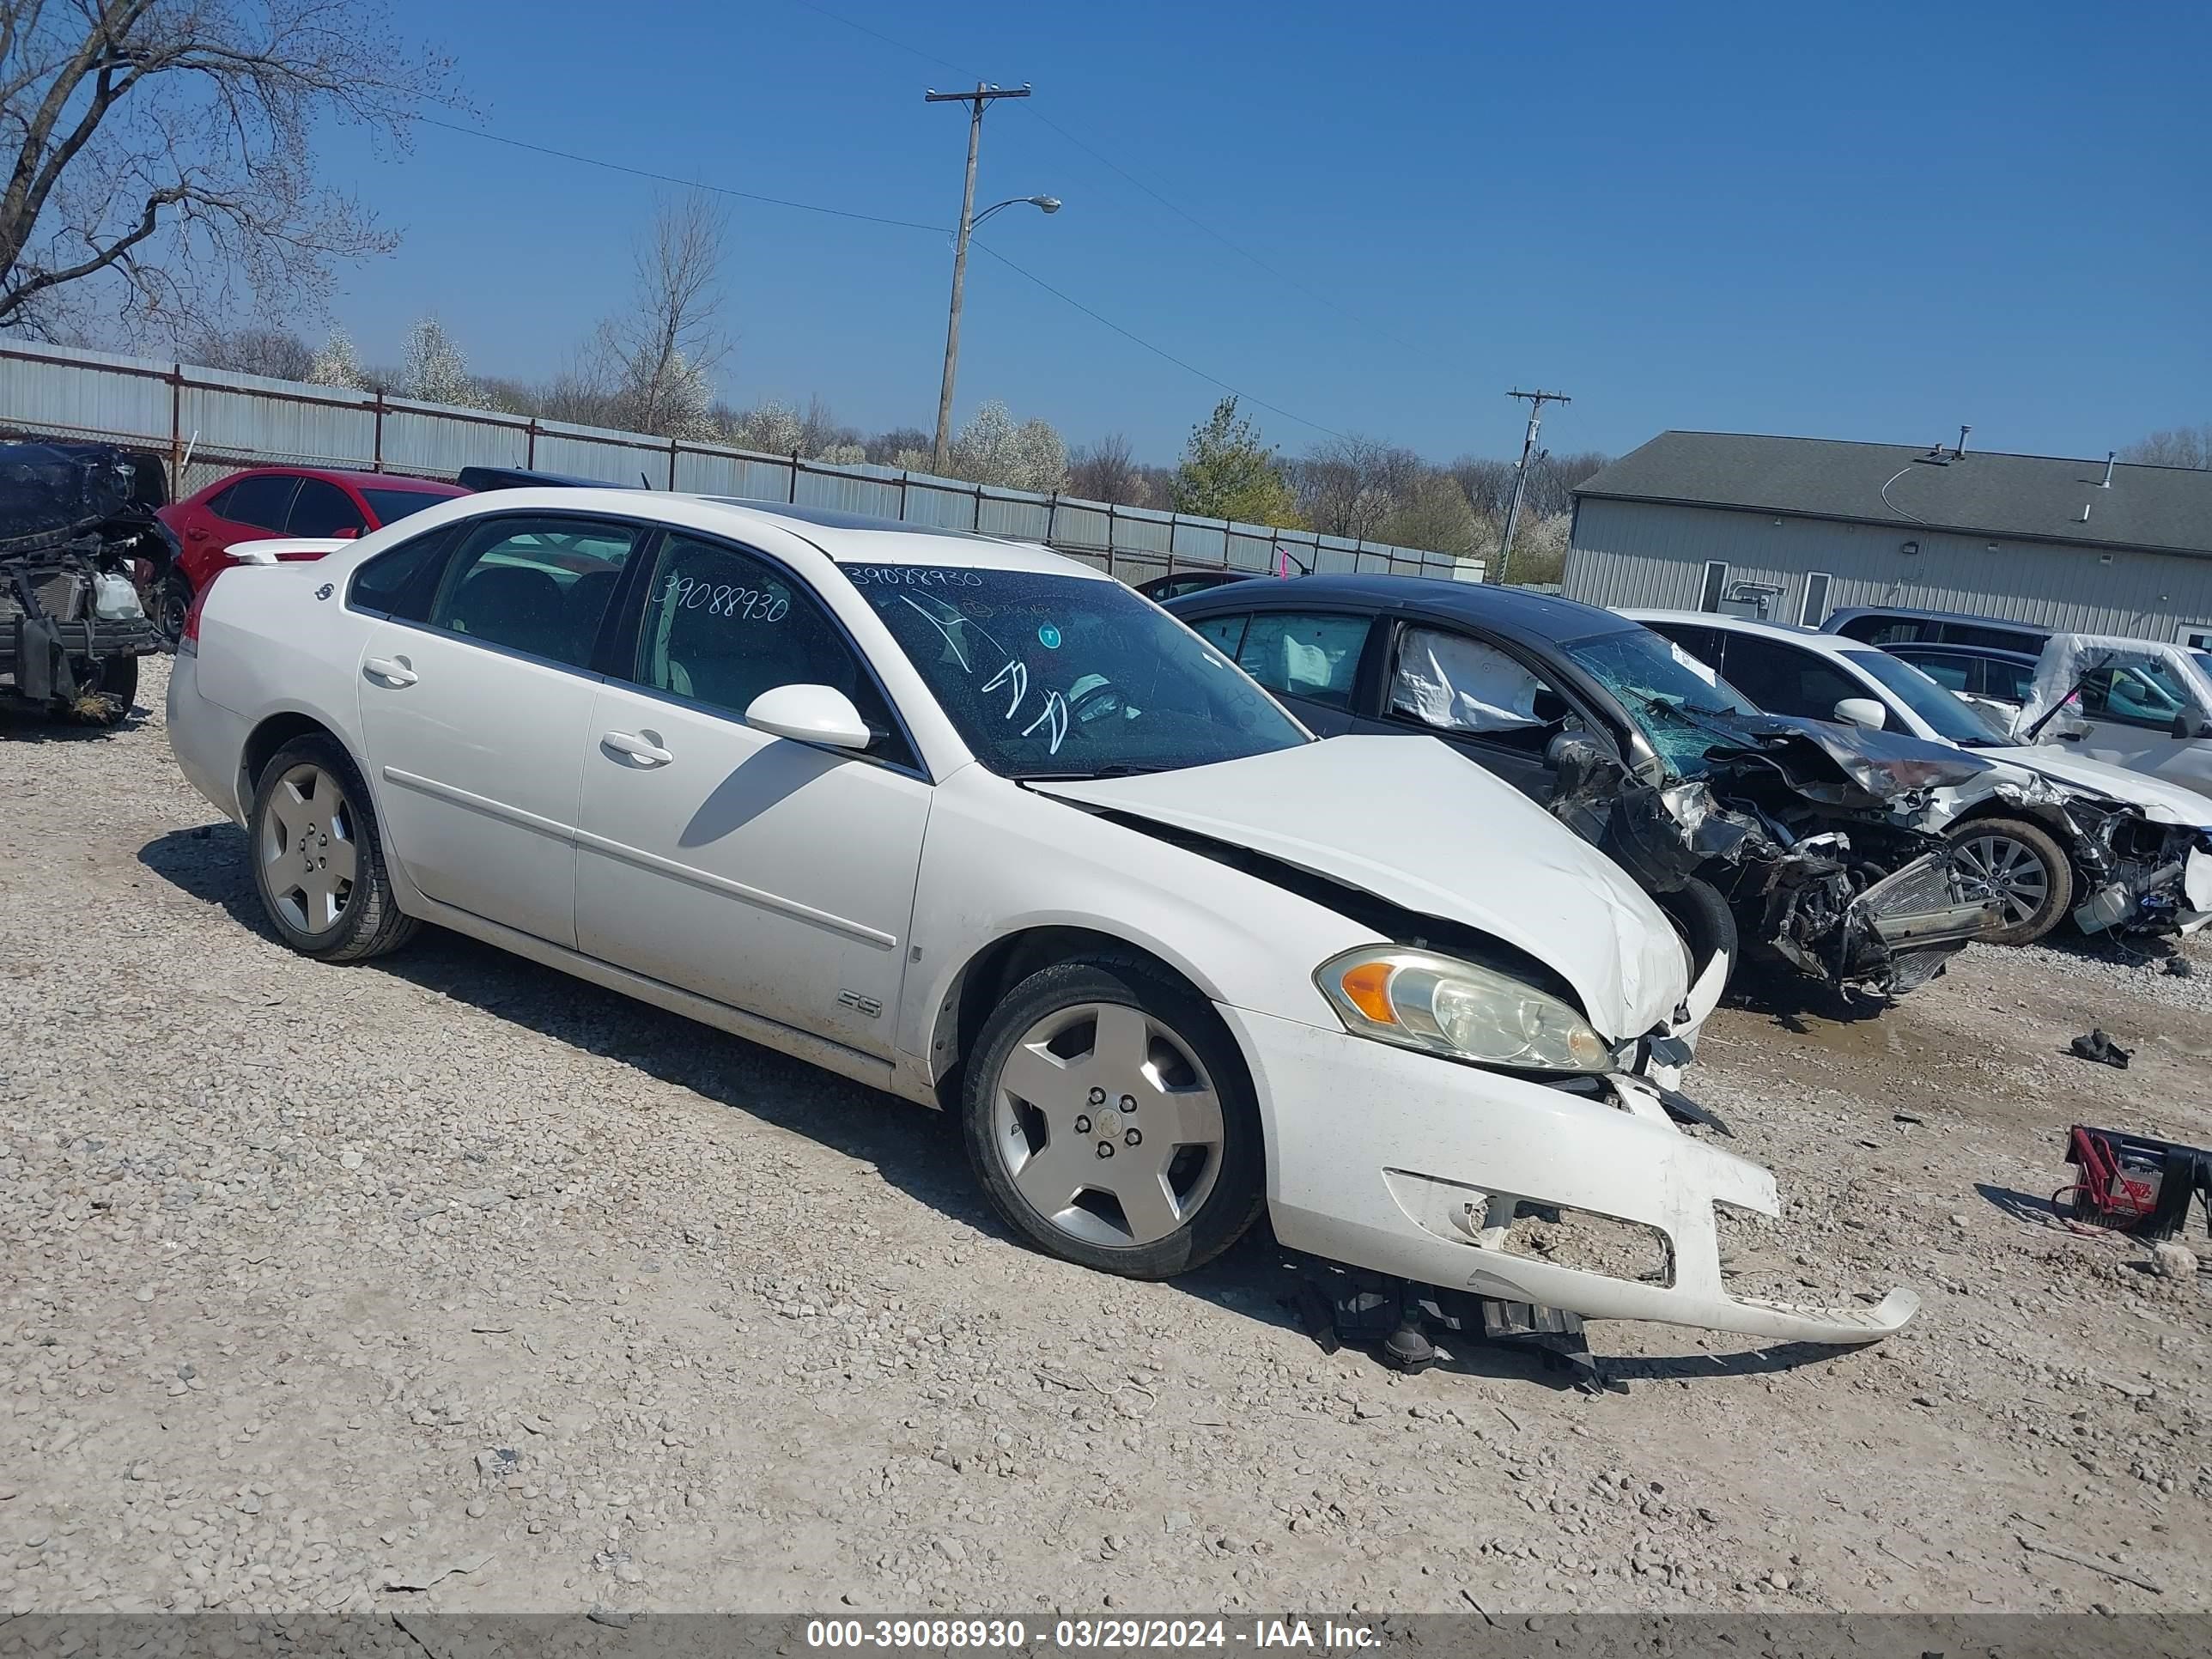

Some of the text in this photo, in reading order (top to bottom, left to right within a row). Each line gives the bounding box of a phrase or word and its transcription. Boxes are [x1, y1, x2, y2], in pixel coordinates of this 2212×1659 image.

[845, 567, 981, 586] 39088930
[653, 575, 788, 622] 39088930
[838, 988, 883, 1018] SS
